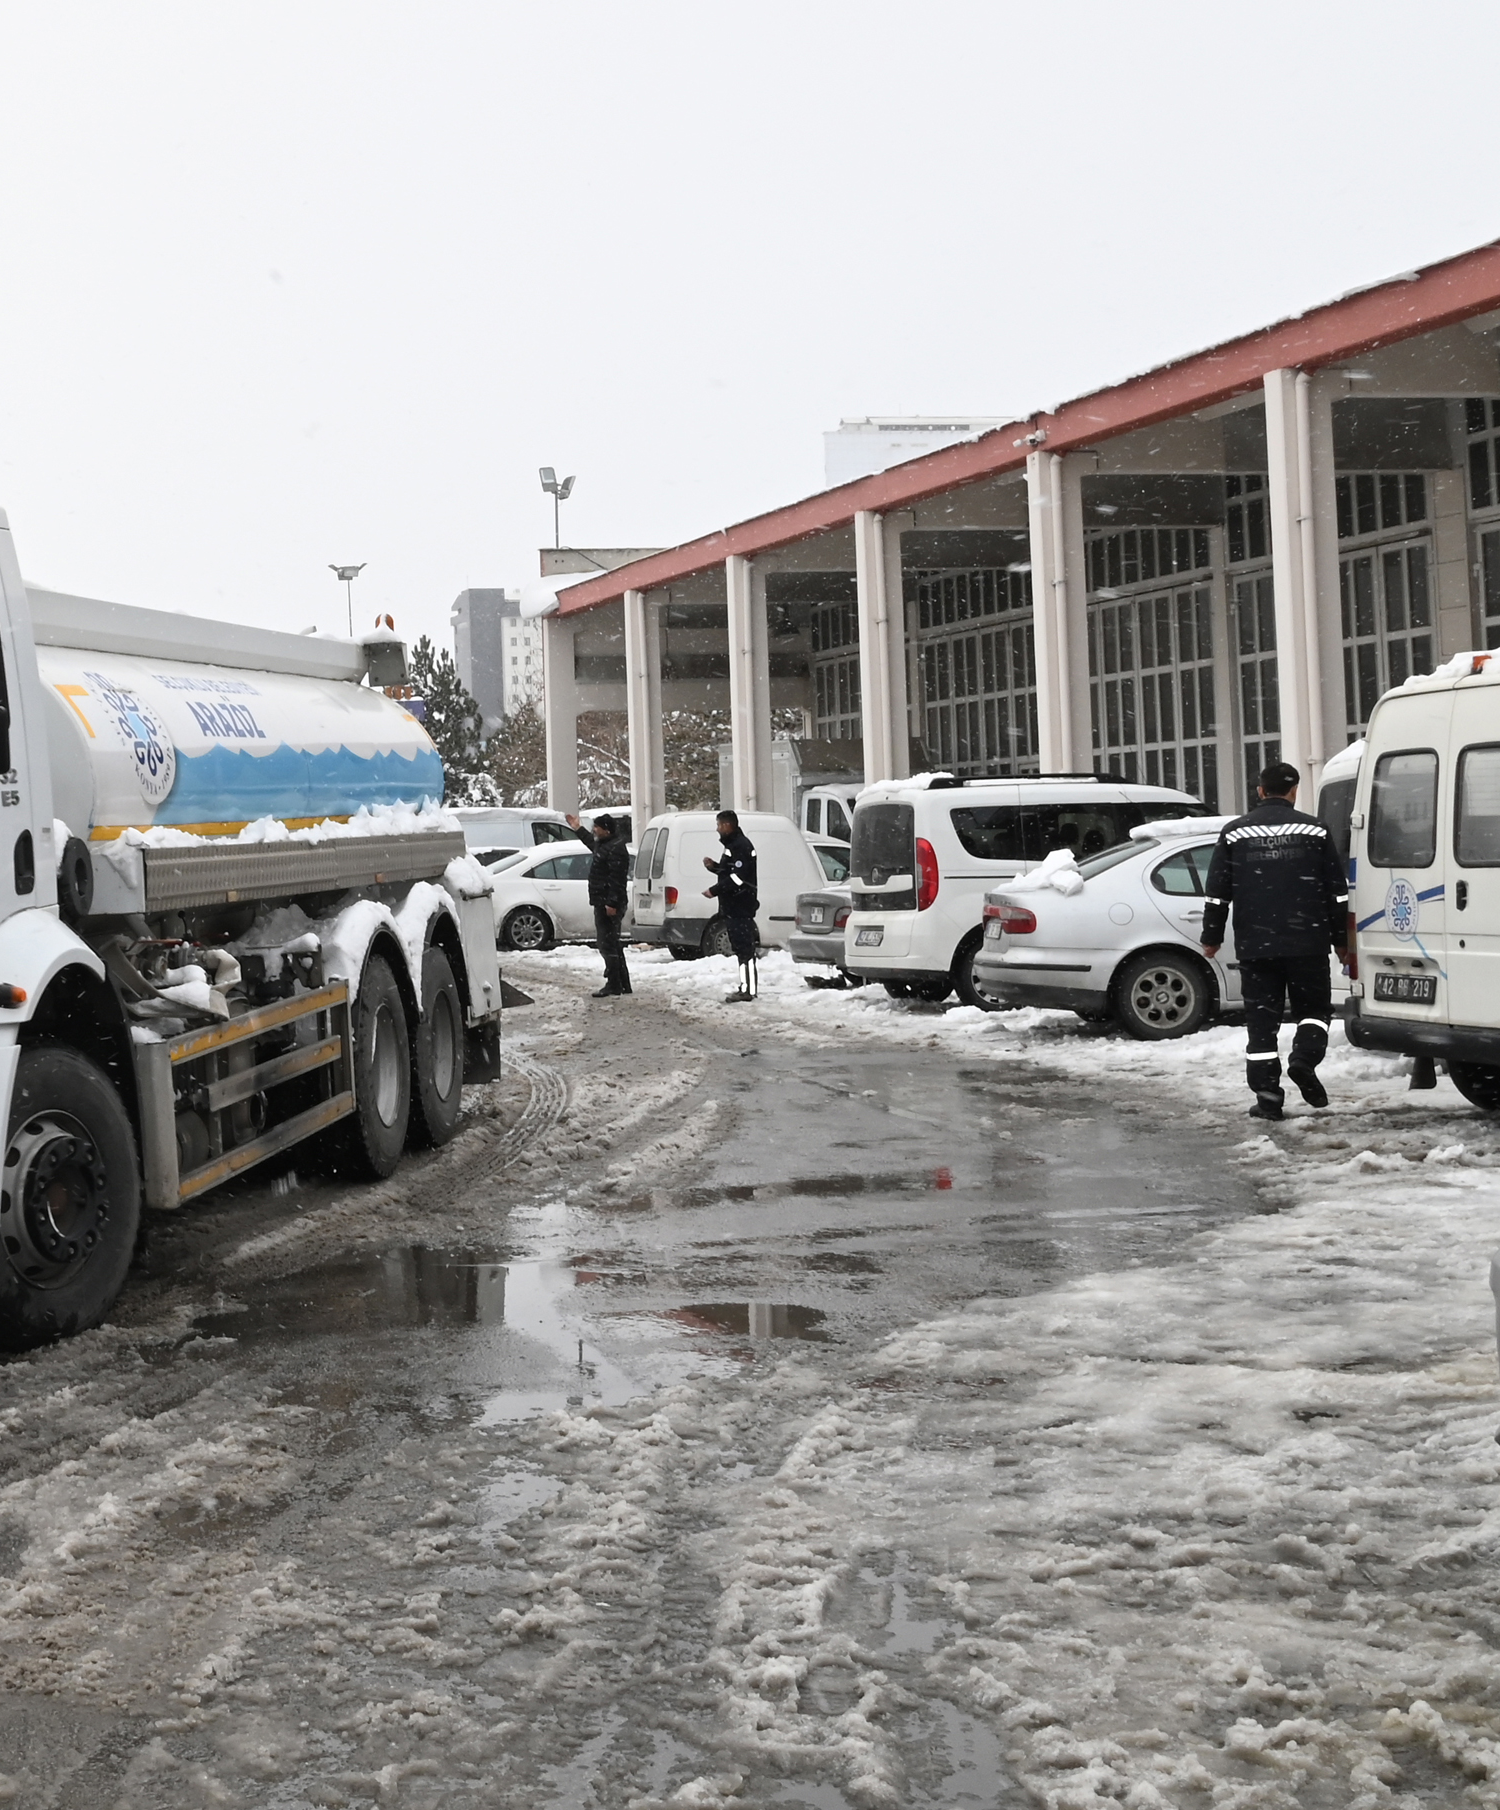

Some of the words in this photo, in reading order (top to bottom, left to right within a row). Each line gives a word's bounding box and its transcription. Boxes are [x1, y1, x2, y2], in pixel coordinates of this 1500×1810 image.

[185, 695, 266, 738] ARAZÖZ
[1, 790, 20, 807] E5
[1382, 977, 1394, 995] 42
[1412, 979, 1430, 997] 219
